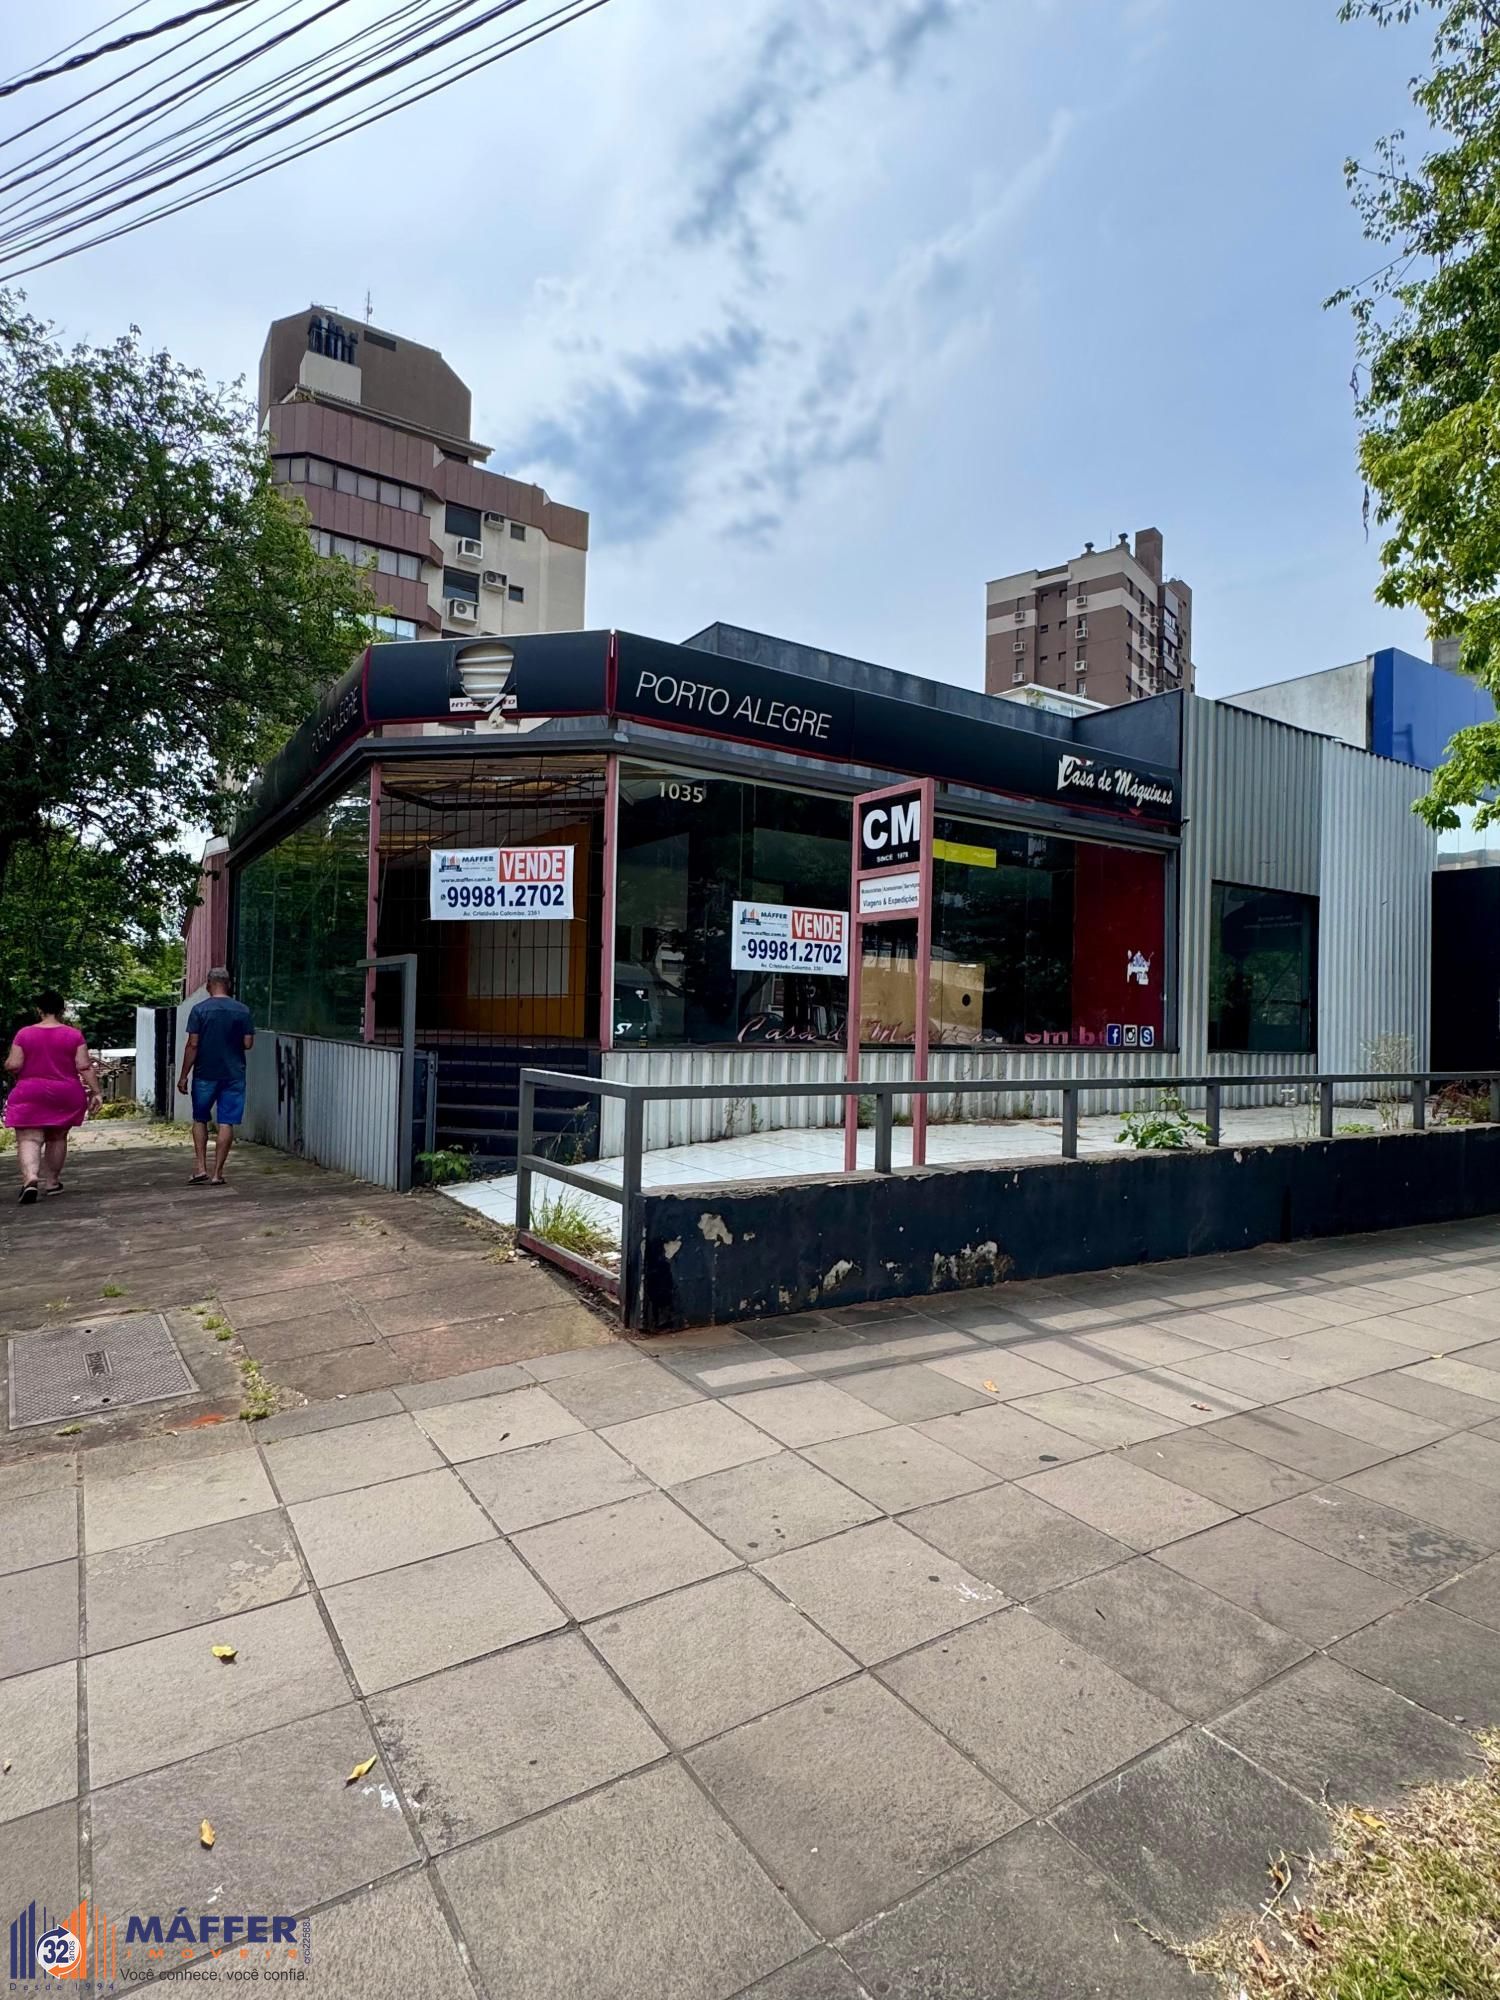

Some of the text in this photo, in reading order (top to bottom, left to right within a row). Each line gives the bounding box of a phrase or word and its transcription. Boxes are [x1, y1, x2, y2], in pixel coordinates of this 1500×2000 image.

[635, 671, 832, 739] PORTO ALEGRE
[1057, 757, 1094, 790] Casa
[1098, 769, 1112, 792] de
[659, 781, 703, 803] 1035
[863, 800, 920, 850] CM
[501, 852, 564, 880] VENDE
[876, 854, 893, 863] SINCE
[447, 884, 565, 908] 99981.2702
[863, 898, 882, 909] Viagens
[888, 894, 918, 905] Expedições
[794, 912, 841, 941] VENDE
[747, 939, 842, 964] 99981.2702
[737, 1016, 817, 1043] Casa
